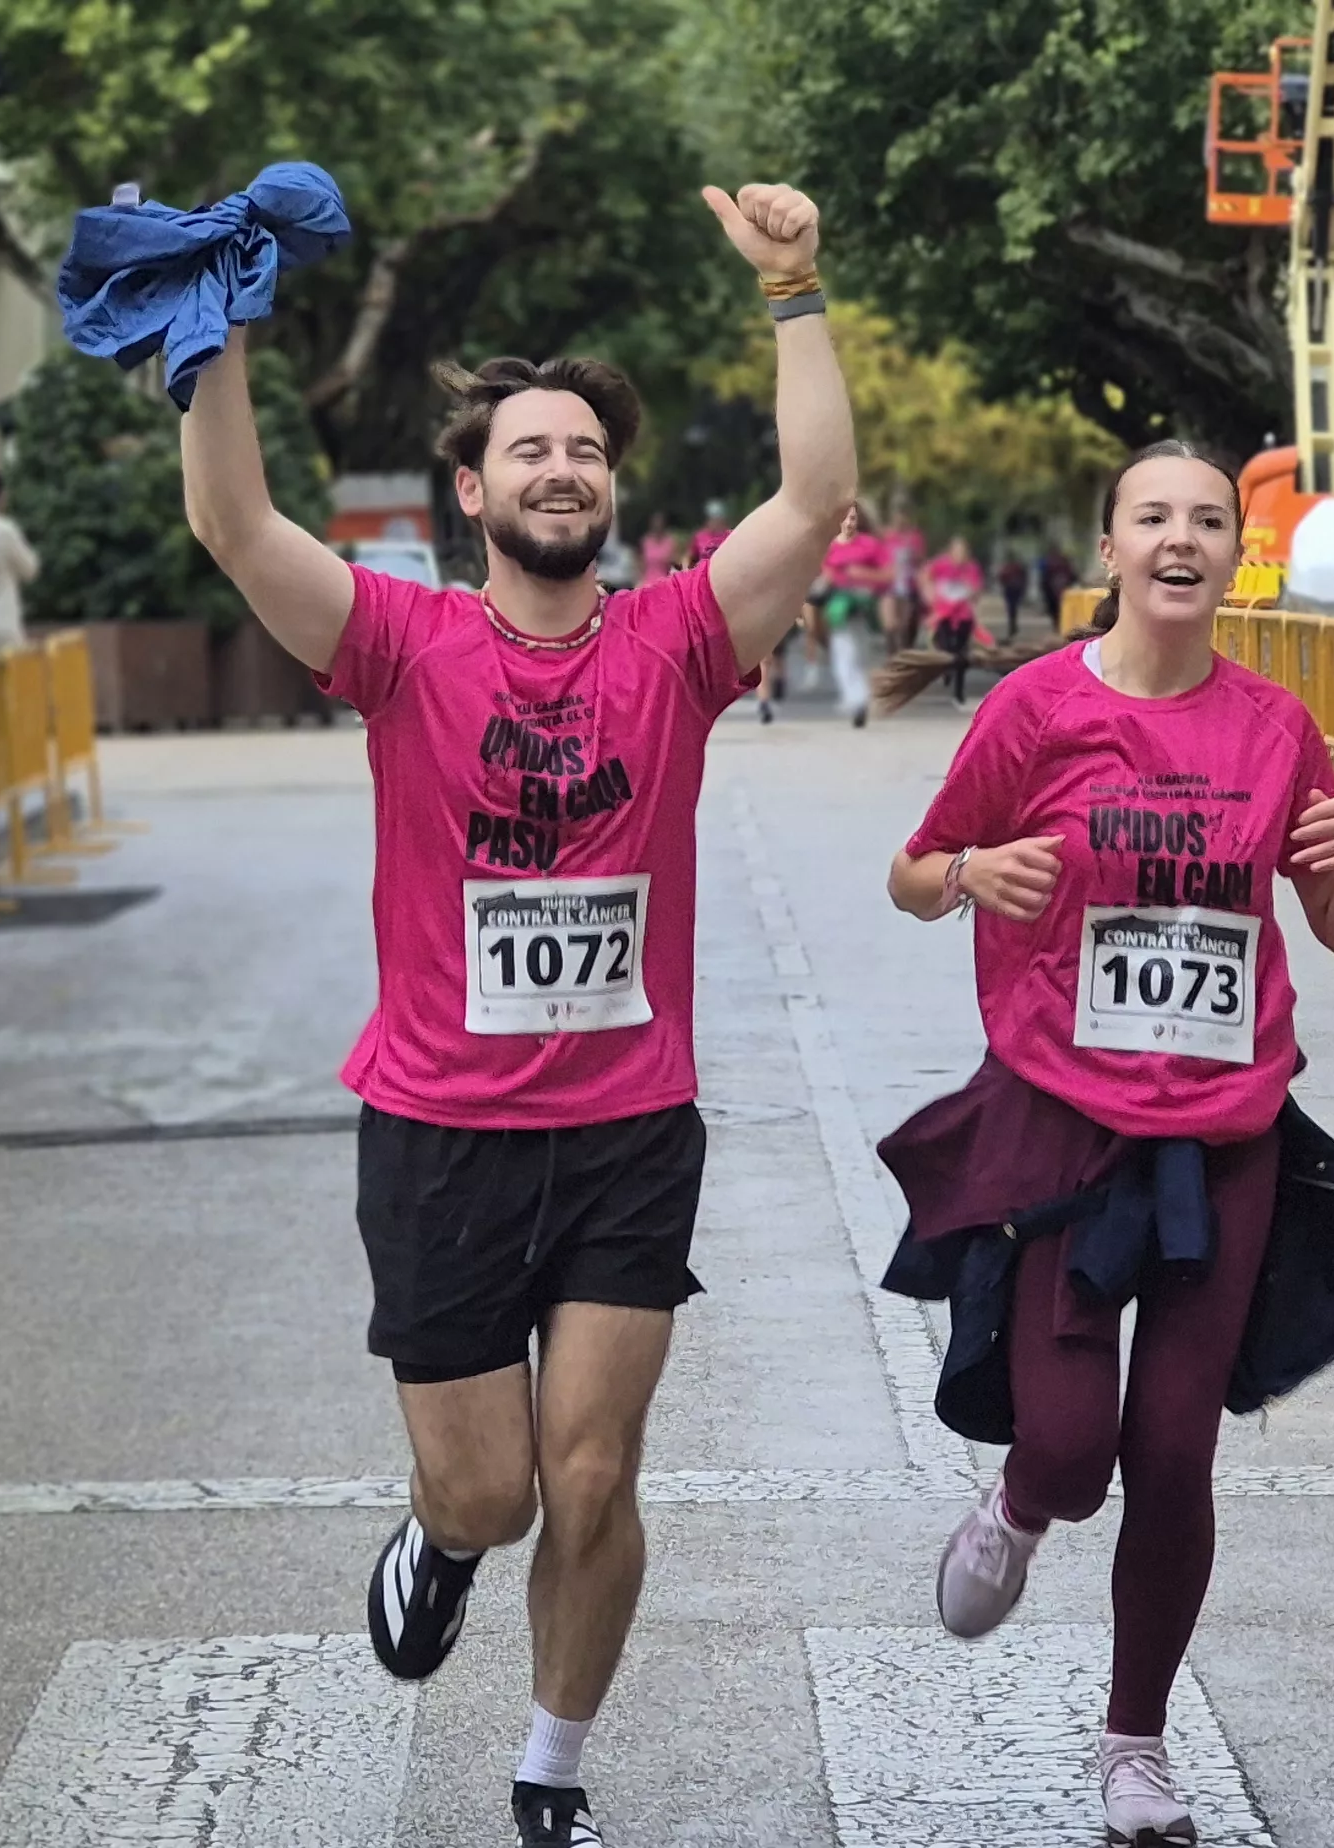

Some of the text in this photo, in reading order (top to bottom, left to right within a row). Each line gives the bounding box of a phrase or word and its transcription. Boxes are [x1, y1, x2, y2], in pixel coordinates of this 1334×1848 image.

[480, 715, 586, 776] UNIDOS
[520, 775, 559, 821] EN
[1089, 806, 1208, 857] UNIDOS
[1138, 857, 1177, 908] EN
[487, 908, 553, 927] CONTRA
[557, 910, 575, 926] EL
[1104, 928, 1168, 949] CONTRA
[1171, 934, 1189, 951] EL
[488, 930, 631, 988] 1072
[1101, 952, 1240, 1016] 1073
